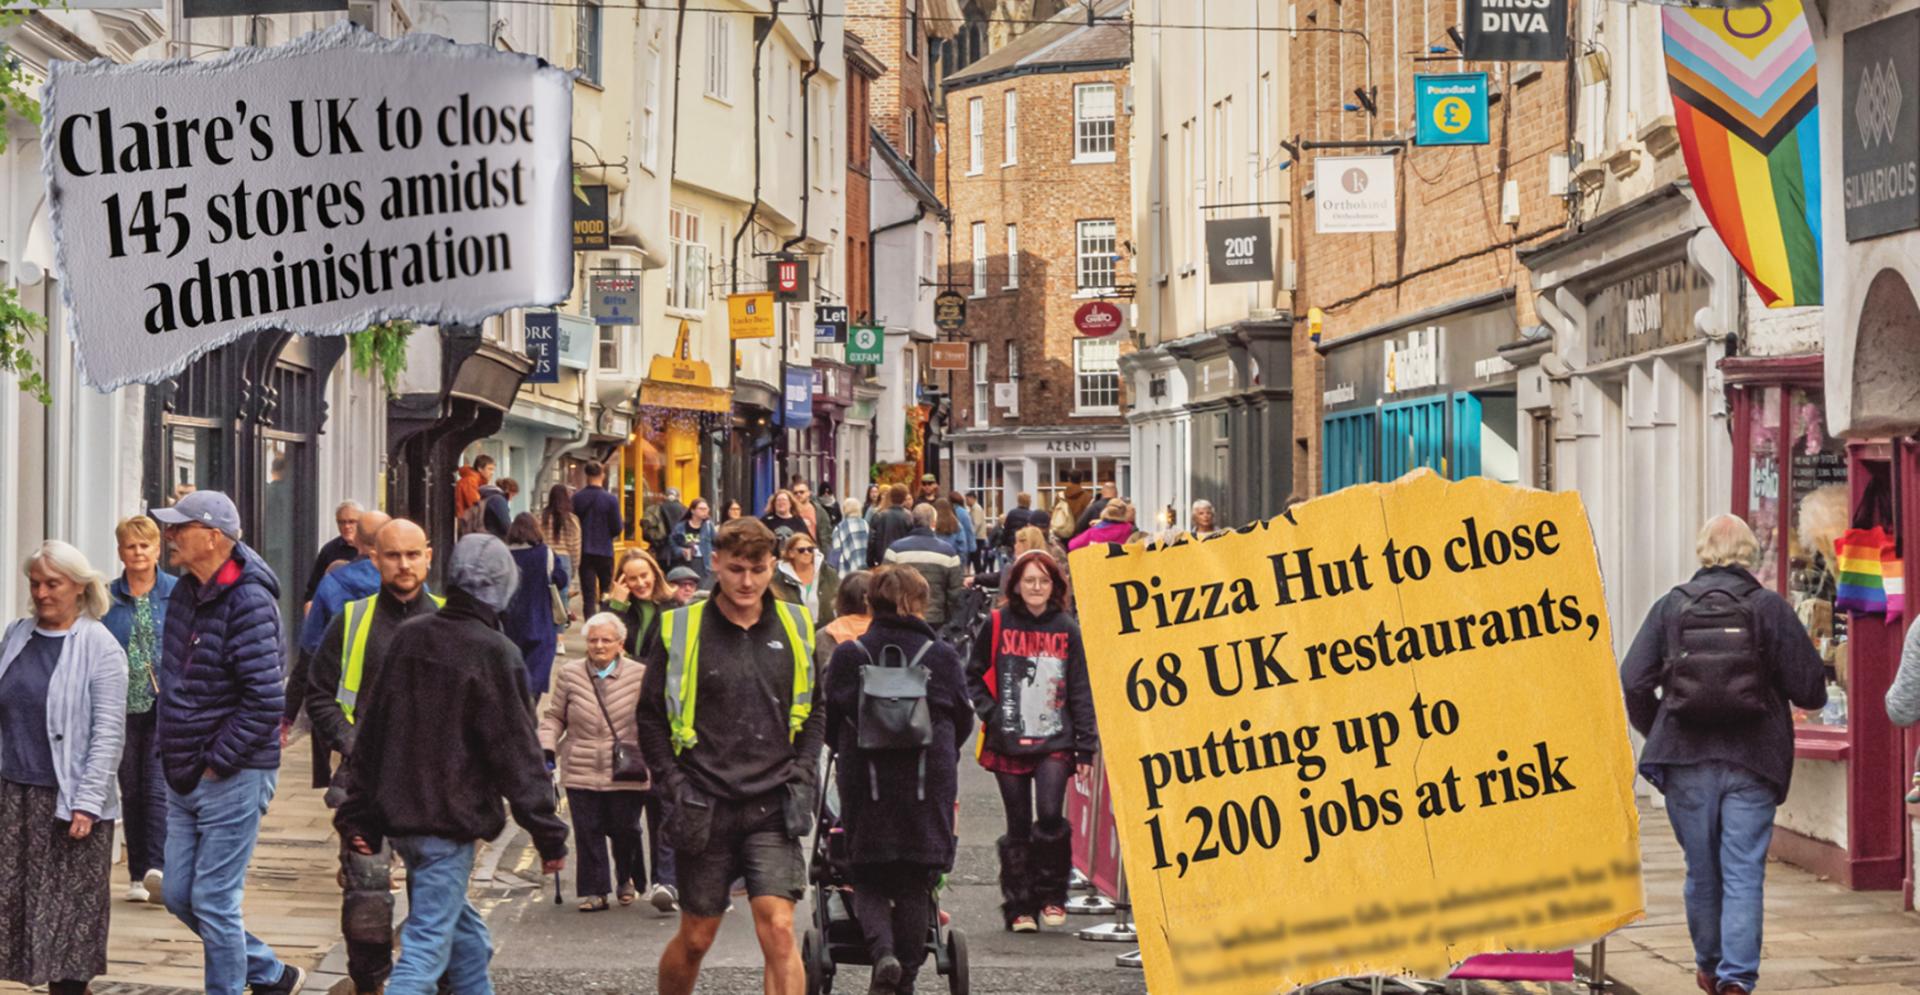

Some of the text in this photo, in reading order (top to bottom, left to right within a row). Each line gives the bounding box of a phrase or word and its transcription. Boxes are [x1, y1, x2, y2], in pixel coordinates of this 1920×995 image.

[1482, 12, 1549, 33] DIVA
[1427, 85, 1476, 95] Poundland
[1845, 161, 1916, 209] SILVARIOUS
[1322, 199, 1388, 210] Orthokind
[822, 309, 846, 322] Let
[850, 352, 880, 362] OXFAM
[1046, 441, 1096, 451] AZENDI
[1001, 629, 1069, 660] SCARFACE
